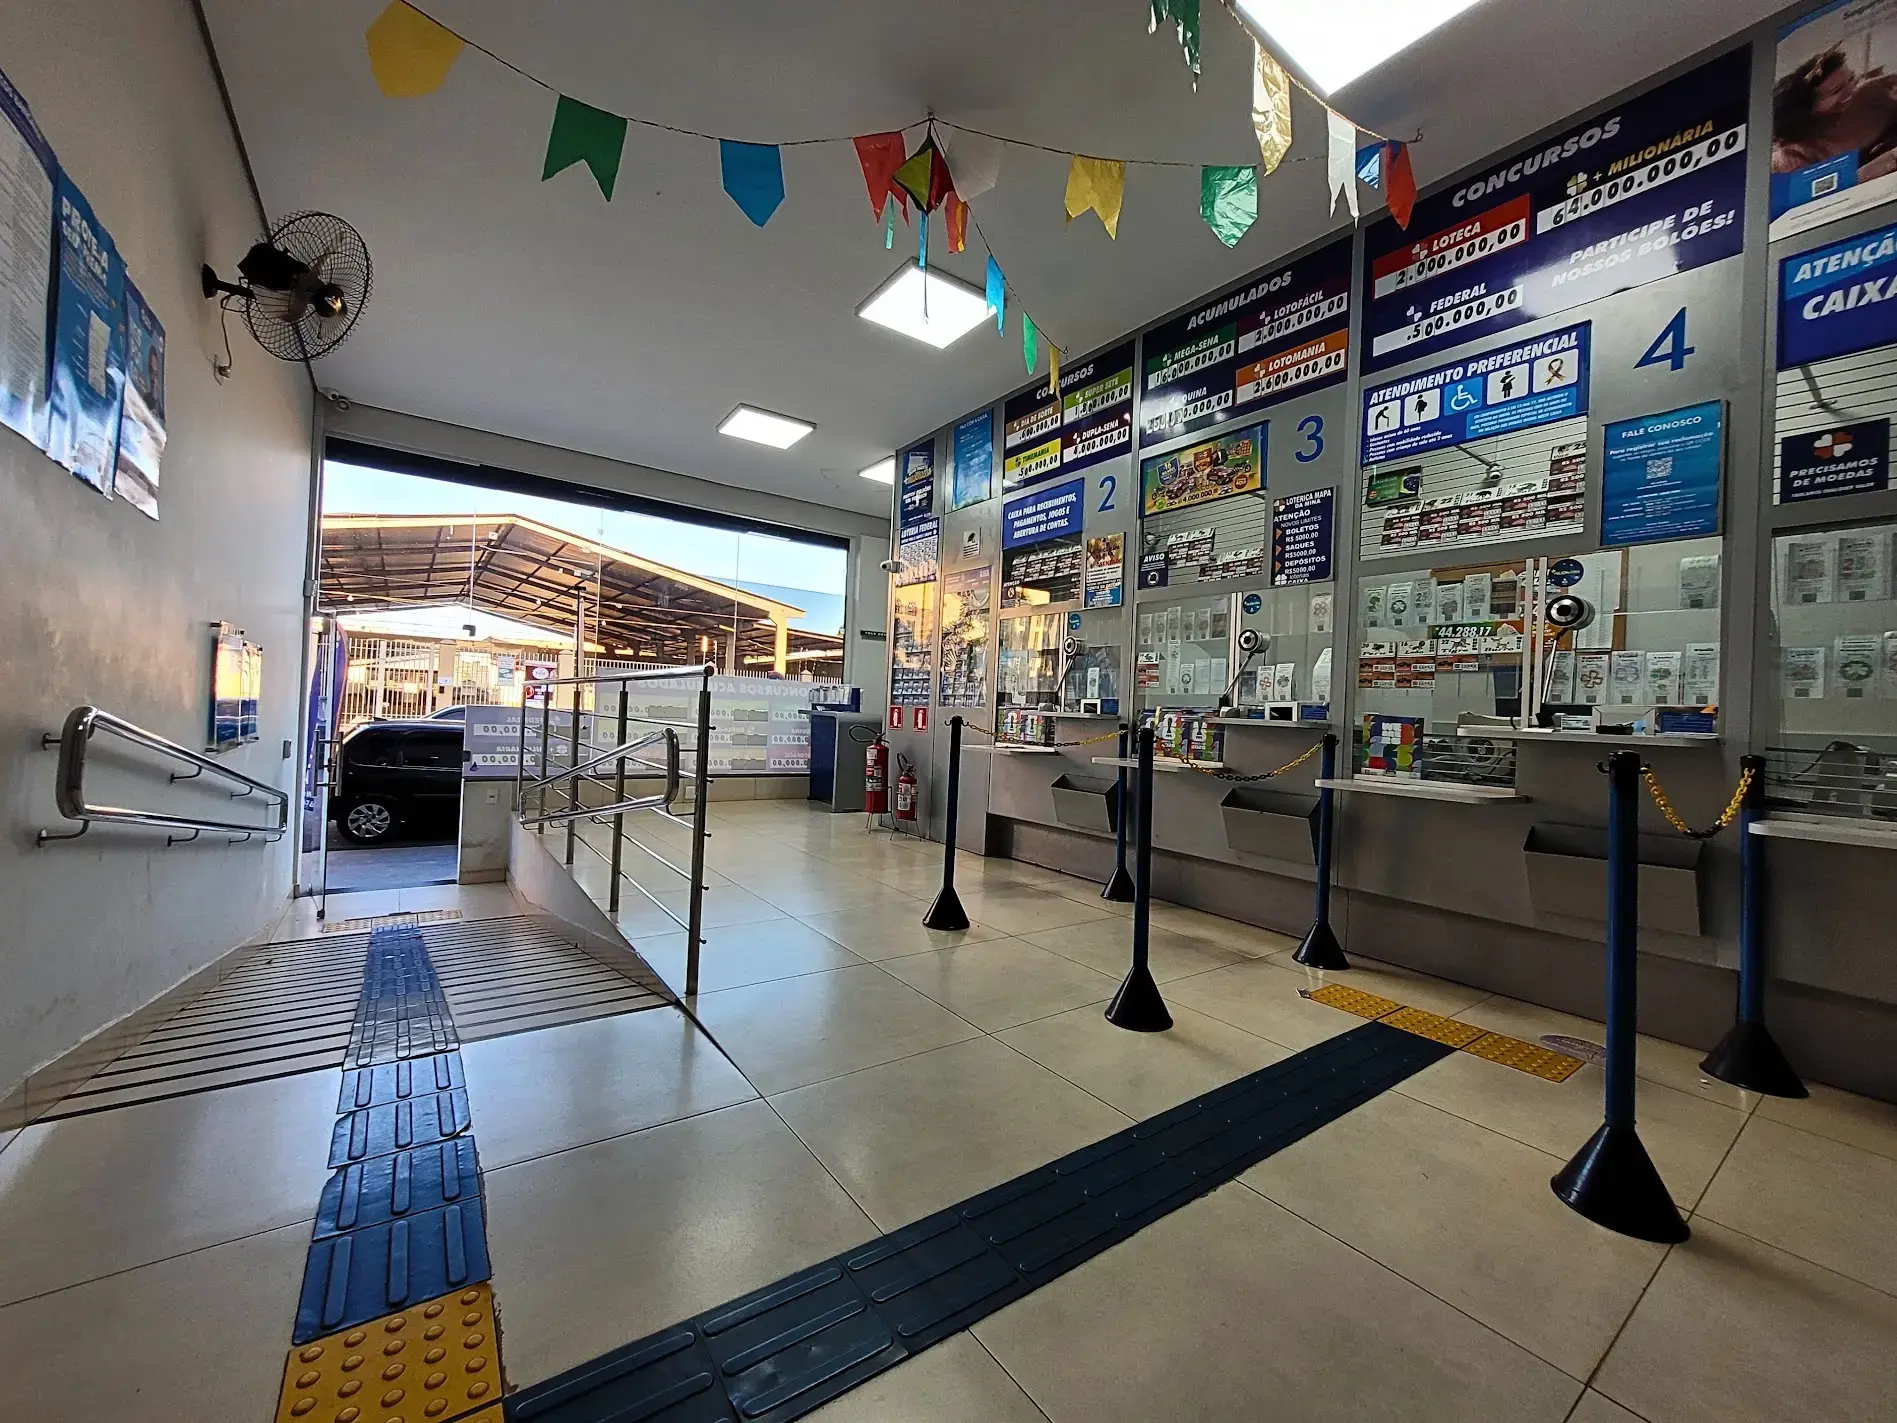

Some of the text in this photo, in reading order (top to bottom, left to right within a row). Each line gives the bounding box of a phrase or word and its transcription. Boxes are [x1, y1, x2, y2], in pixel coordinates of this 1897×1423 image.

[1608, 120, 1713, 176] MILIONÁRIA
[1452, 116, 1622, 208] CONCURSOS
[1552, 130, 1739, 226] 64.000.000,00
[1432, 222, 1481, 251] LOTECA
[1569, 200, 1713, 264] PARTICIPE DE
[1396, 223, 1520, 286] 2.000.000,00
[1552, 210, 1736, 288] NOSSOS BOLÕES!
[1793, 231, 1897, 284] ATENÇÃ
[1187, 271, 1292, 331] ACUMULADOS
[1274, 290, 1324, 319] LOTOFÁCIL
[1430, 283, 1487, 313] FEDERAL
[1255, 296, 1344, 343] 2.000.000,00
[1174, 335, 1219, 361] MEGA-SENA
[1634, 307, 1696, 372] 4
[1268, 342, 1326, 372] LOTOMANIA
[1369, 332, 1578, 406] ATENDIMENTO PREFERENCIAL
[1036, 364, 1094, 400] COURSOS
[1254, 352, 1341, 394] 2.600.000,00
[1084, 377, 1118, 398] SUPER SETE
[1182, 386, 1207, 403] QUINA
[1020, 406, 1054, 428] DIA DE SORTE
[1082, 419, 1118, 440] DUPLA-SENA
[1622, 416, 1702, 438] FALE CONOSCO
[1295, 416, 1324, 463] 3
[1626, 442, 1656, 452] registrar
[1789, 458, 1878, 478] PRECISAMOS
[1793, 468, 1874, 488] DE MOEDAS
[1008, 493, 1076, 520] CAIXA PARA RECEBIMENTOS,
[1098, 476, 1117, 513] 2
[1286, 489, 1332, 506] LOTÉRICA MAPA
[1304, 498, 1321, 506] MINA
[1014, 506, 1070, 529] PAGAMENTOS, JOGOS E
[1274, 509, 1310, 522] ATENÇÃO
[1281, 515, 1322, 528] NOVOS LIMITES
[901, 526, 919, 538] LOTERIA
[920, 520, 938, 534] FEDERAL
[1013, 518, 1069, 540] ABERTURA DE CONTAS.
[1286, 524, 1319, 534] BOLETOS
[1144, 553, 1166, 563] AVISO
[1286, 541, 1314, 550] SAQUES
[1285, 556, 1326, 567] DEPÓSITOS
